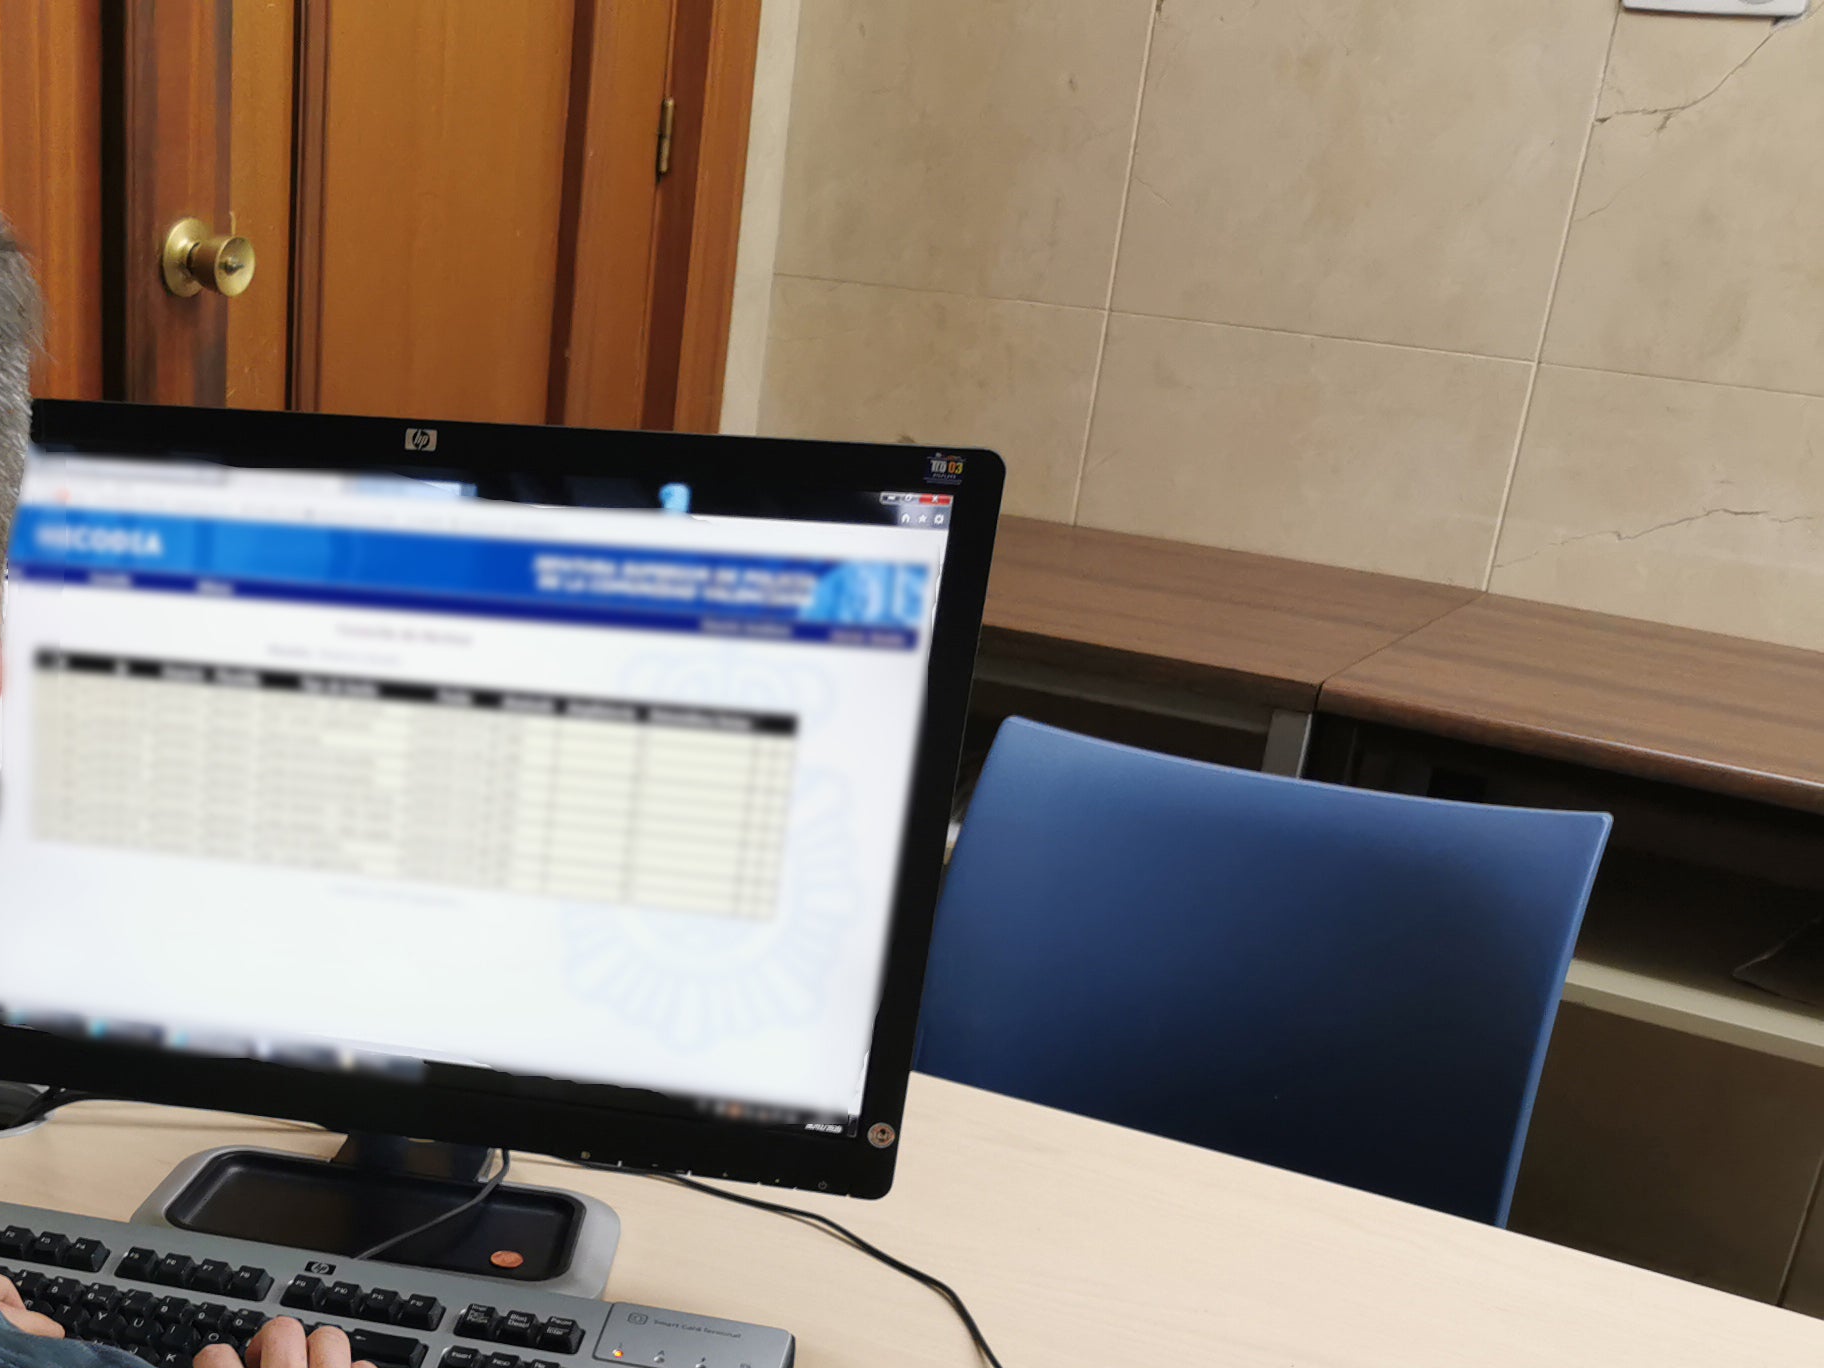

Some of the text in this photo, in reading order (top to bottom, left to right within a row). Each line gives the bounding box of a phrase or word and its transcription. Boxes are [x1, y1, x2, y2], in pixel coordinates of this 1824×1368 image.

[413, 429, 430, 450] hp
[311, 1262, 330, 1275] hp
[654, 1319, 679, 1330] Smart
[681, 1322, 702, 1332] Card
